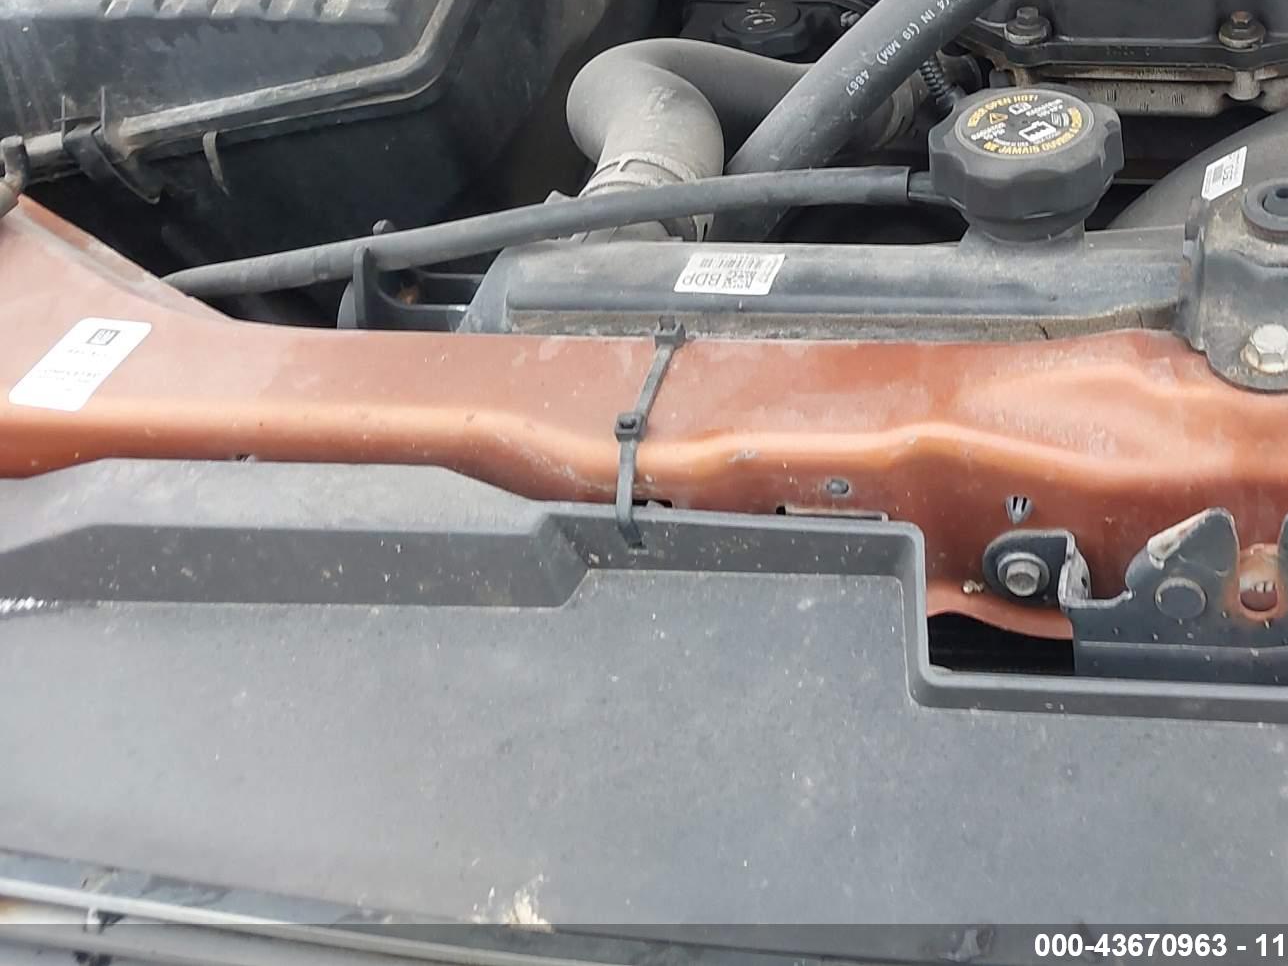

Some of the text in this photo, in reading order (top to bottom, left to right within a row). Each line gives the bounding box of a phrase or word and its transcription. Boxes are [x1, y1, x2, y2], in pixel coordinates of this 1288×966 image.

[920, 9, 936, 24] IN
[902, 22, 920, 40] (19
[876, 40, 901, 65] MM)
[998, 144, 1040, 155] JAMAIS
